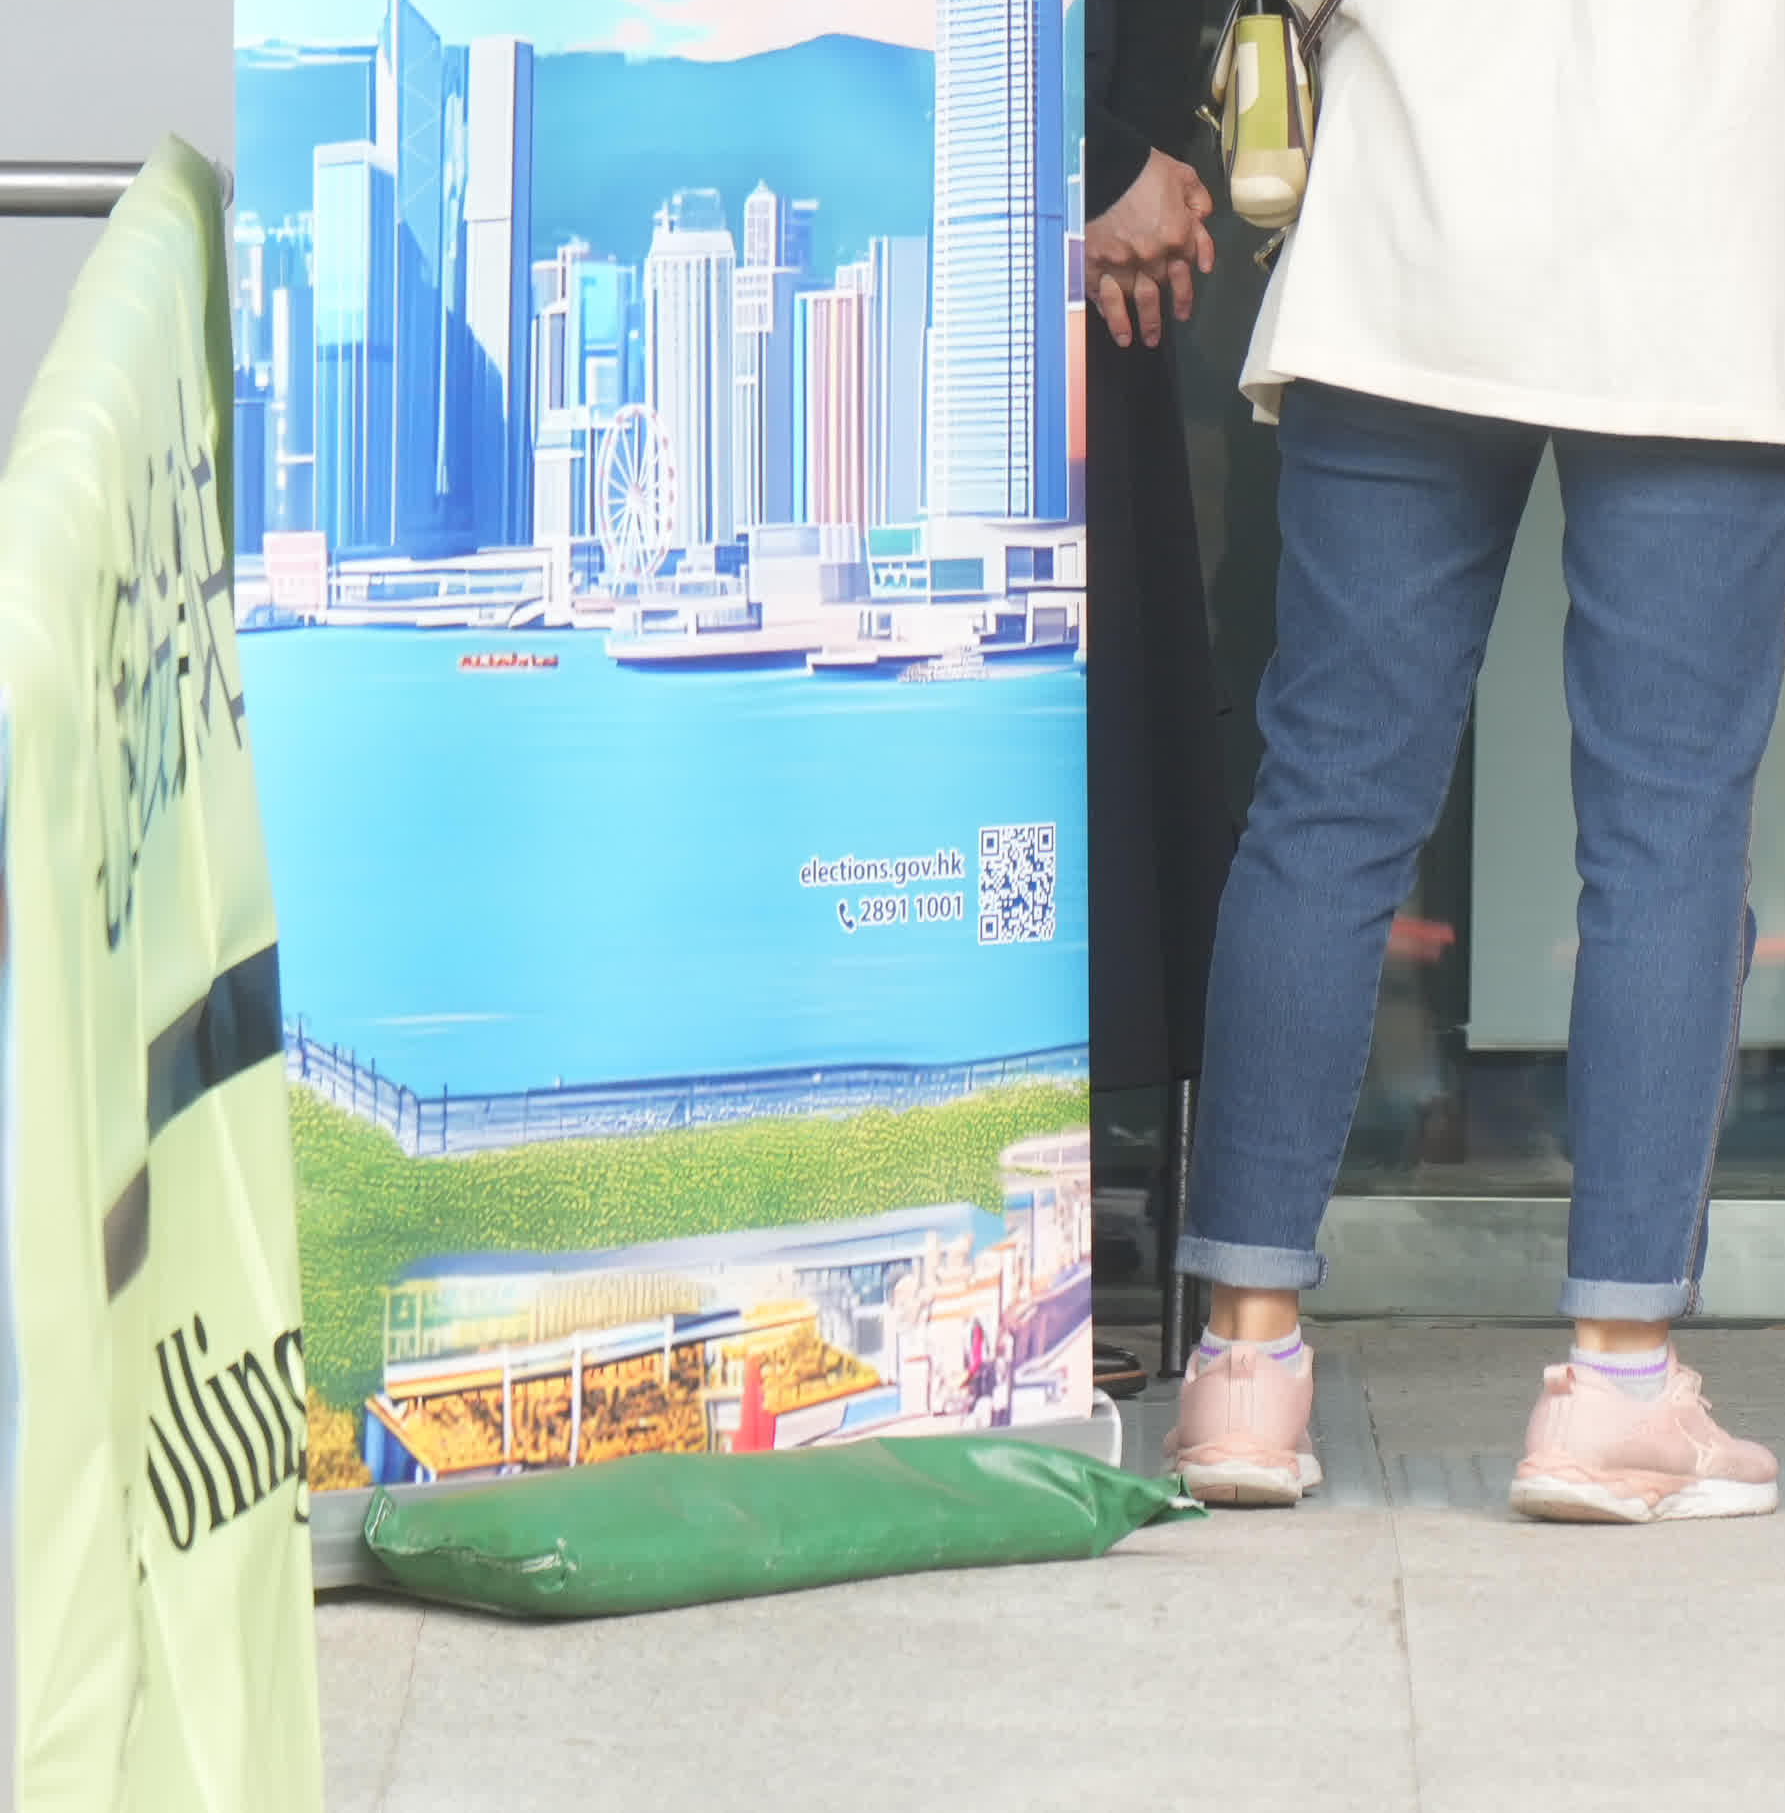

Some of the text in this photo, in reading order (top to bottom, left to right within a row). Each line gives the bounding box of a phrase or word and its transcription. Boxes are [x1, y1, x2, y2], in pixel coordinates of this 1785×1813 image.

[800, 852, 963, 886] elections.gov.hk
[860, 895, 963, 924] 2891 1001
